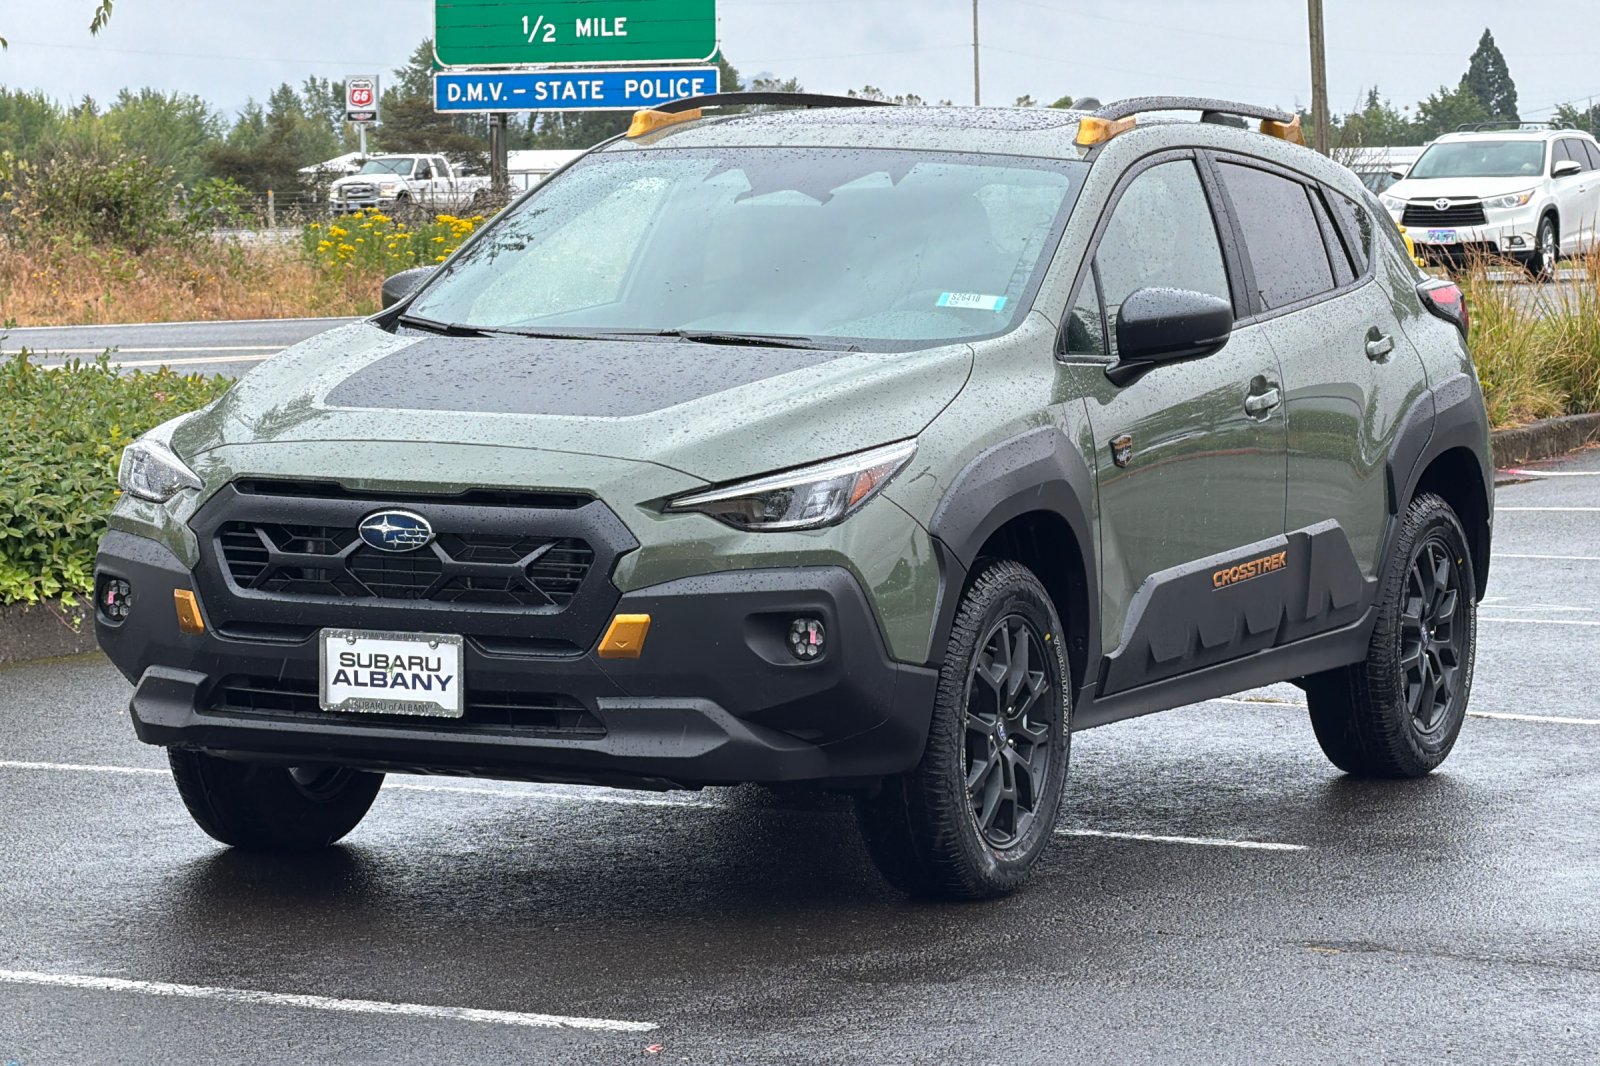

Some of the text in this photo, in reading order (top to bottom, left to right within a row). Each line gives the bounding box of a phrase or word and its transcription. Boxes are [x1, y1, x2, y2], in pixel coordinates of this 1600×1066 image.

[522, 15, 627, 43] 1/2 MILE
[353, 90, 369, 102] 66
[447, 82, 508, 102] D.M.V.
[535, 80, 604, 100] STATE
[625, 78, 705, 99] POLICE
[1213, 551, 1287, 588] CROSSTREK
[339, 652, 442, 673] SUBARU
[332, 669, 453, 692] ALBANY
[354, 701, 387, 711] SUBARU
[396, 702, 431, 713] ALBANY
